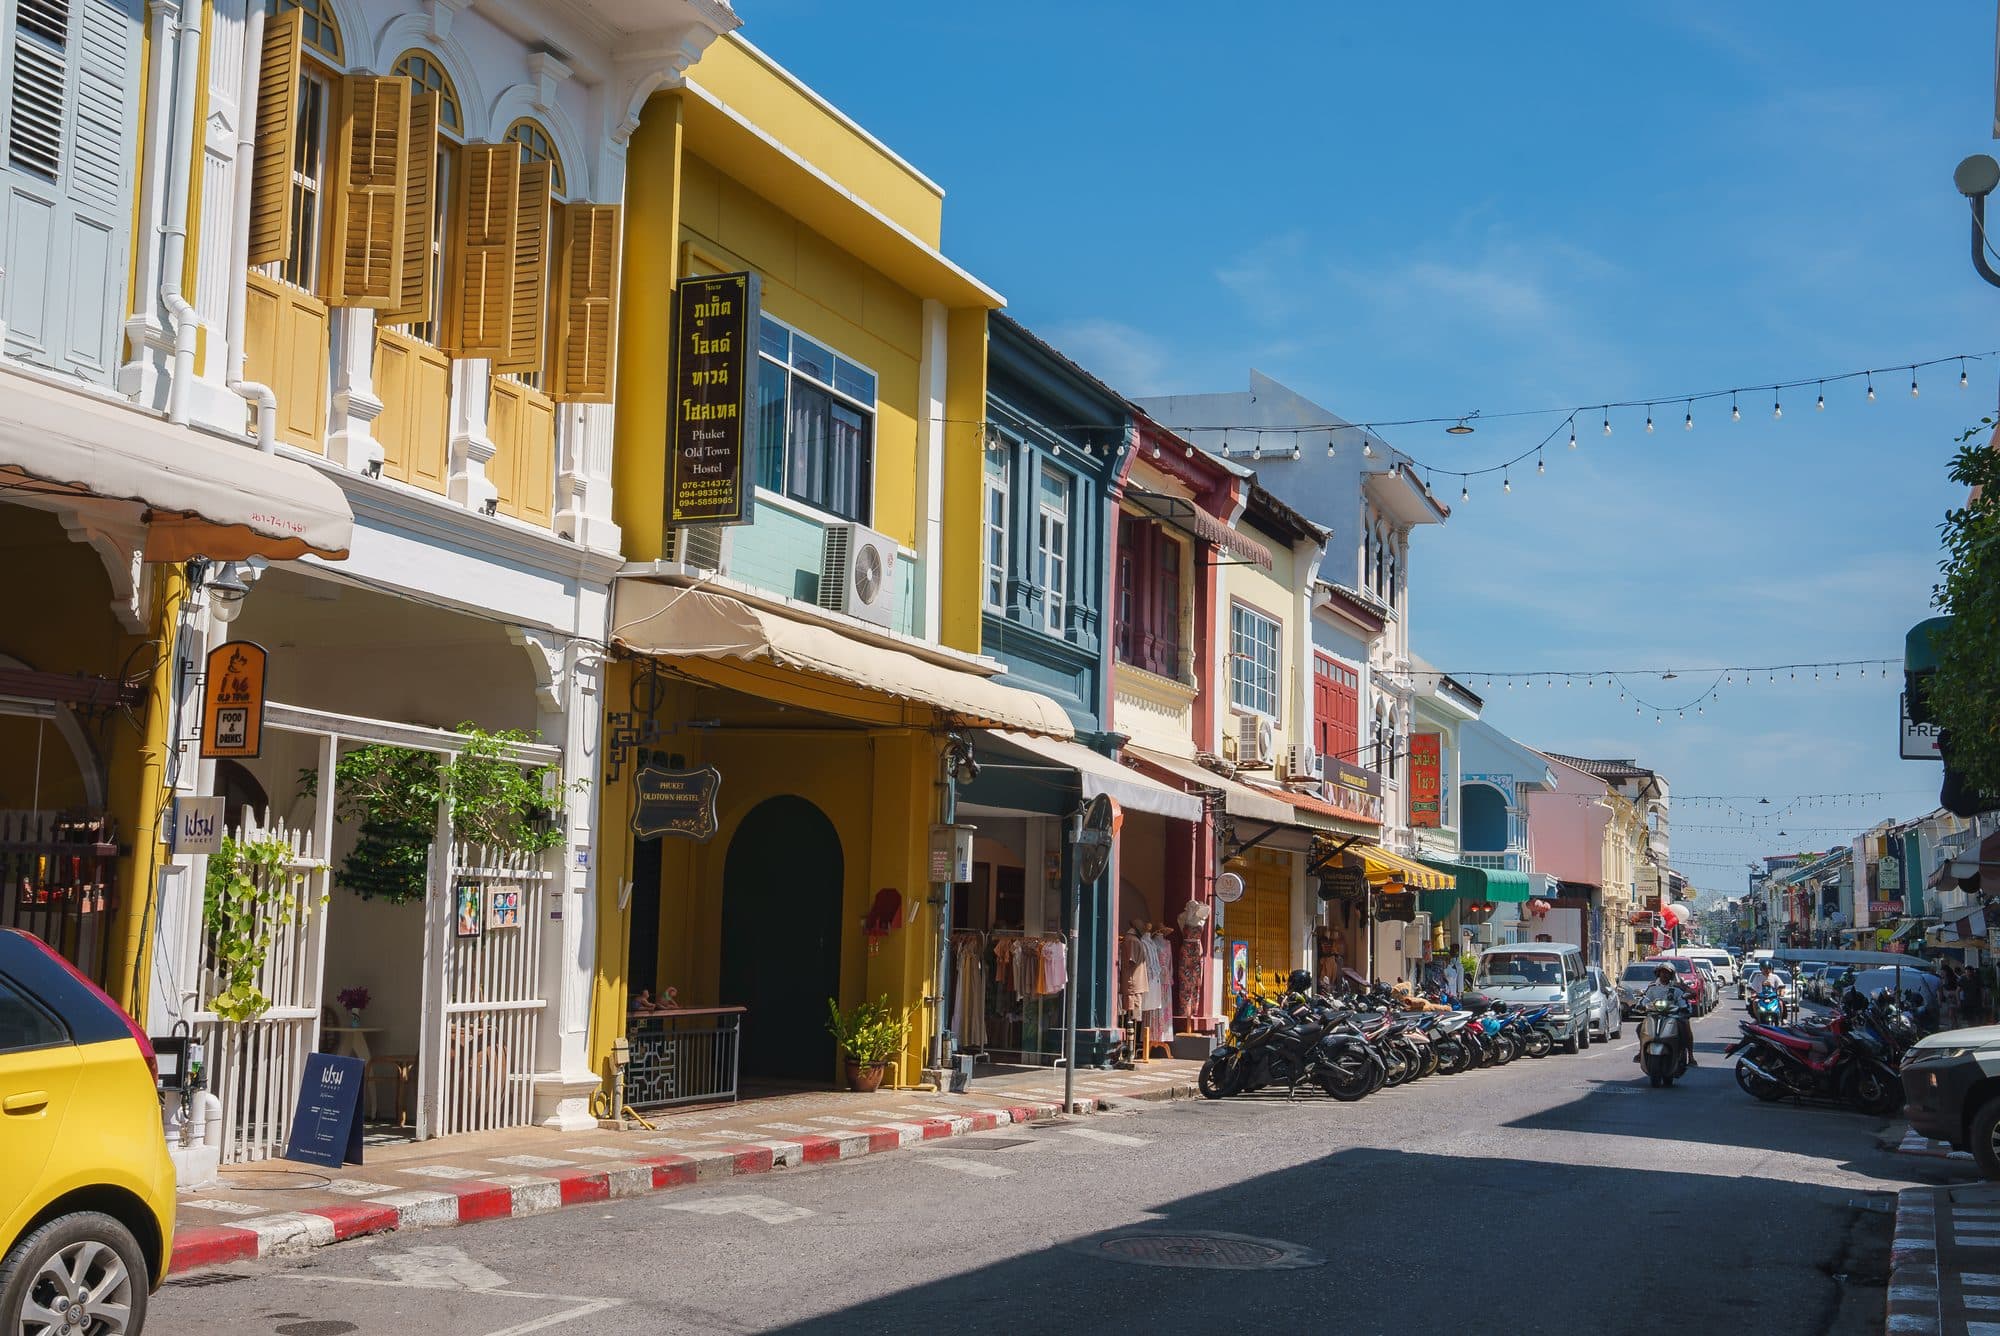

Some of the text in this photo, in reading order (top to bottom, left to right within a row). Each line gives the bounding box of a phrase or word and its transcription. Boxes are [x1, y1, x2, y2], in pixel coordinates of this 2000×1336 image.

[694, 295, 731, 327] ภูเก็ต
[691, 331, 732, 355] โอลด์
[692, 362, 729, 386] ทาวน์
[692, 429, 725, 440] Phuket
[685, 446, 731, 458] Old Town
[693, 462, 722, 474] Hostel
[222, 712, 242, 723] FOOD
[219, 733, 242, 744] DRINKS
[660, 782, 685, 790] PHUKET
